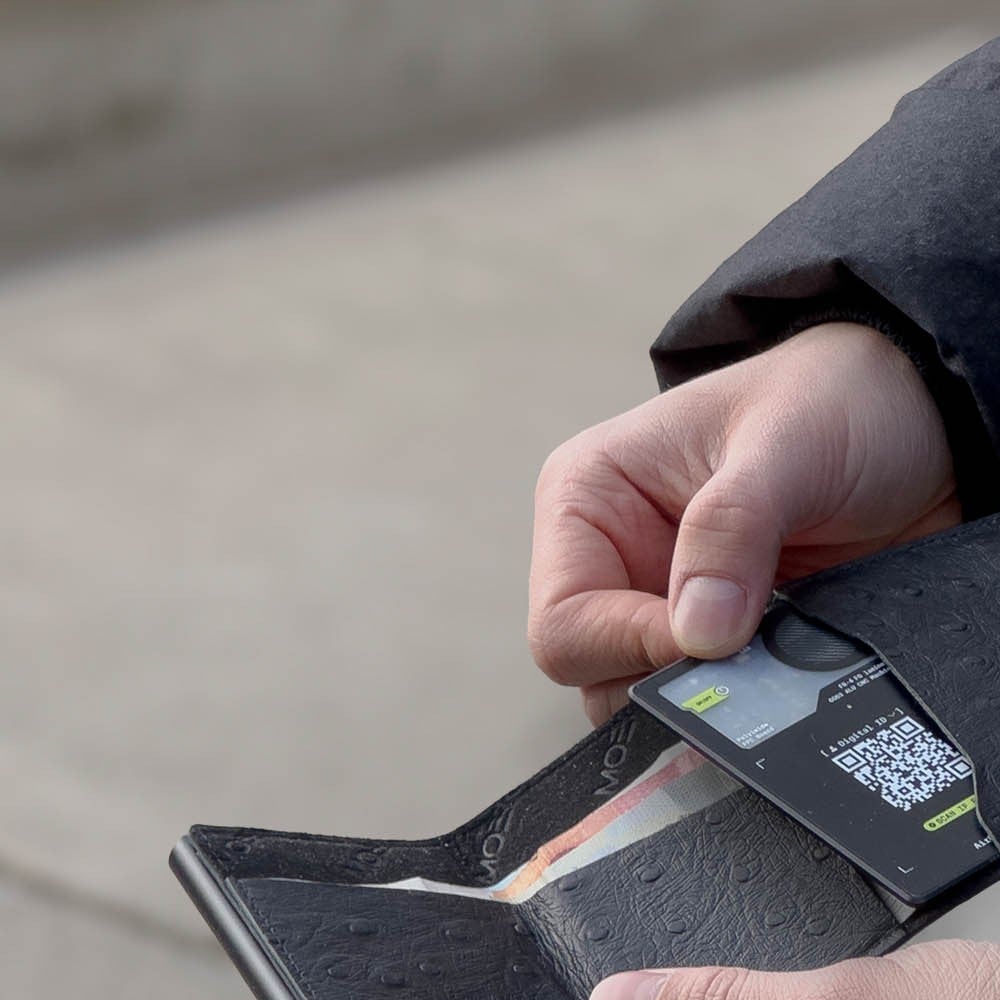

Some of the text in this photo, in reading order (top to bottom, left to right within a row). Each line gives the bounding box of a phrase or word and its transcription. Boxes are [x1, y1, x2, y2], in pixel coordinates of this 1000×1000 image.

[837, 716, 888, 747] Digital ID
[935, 809, 957, 825] SCAN
